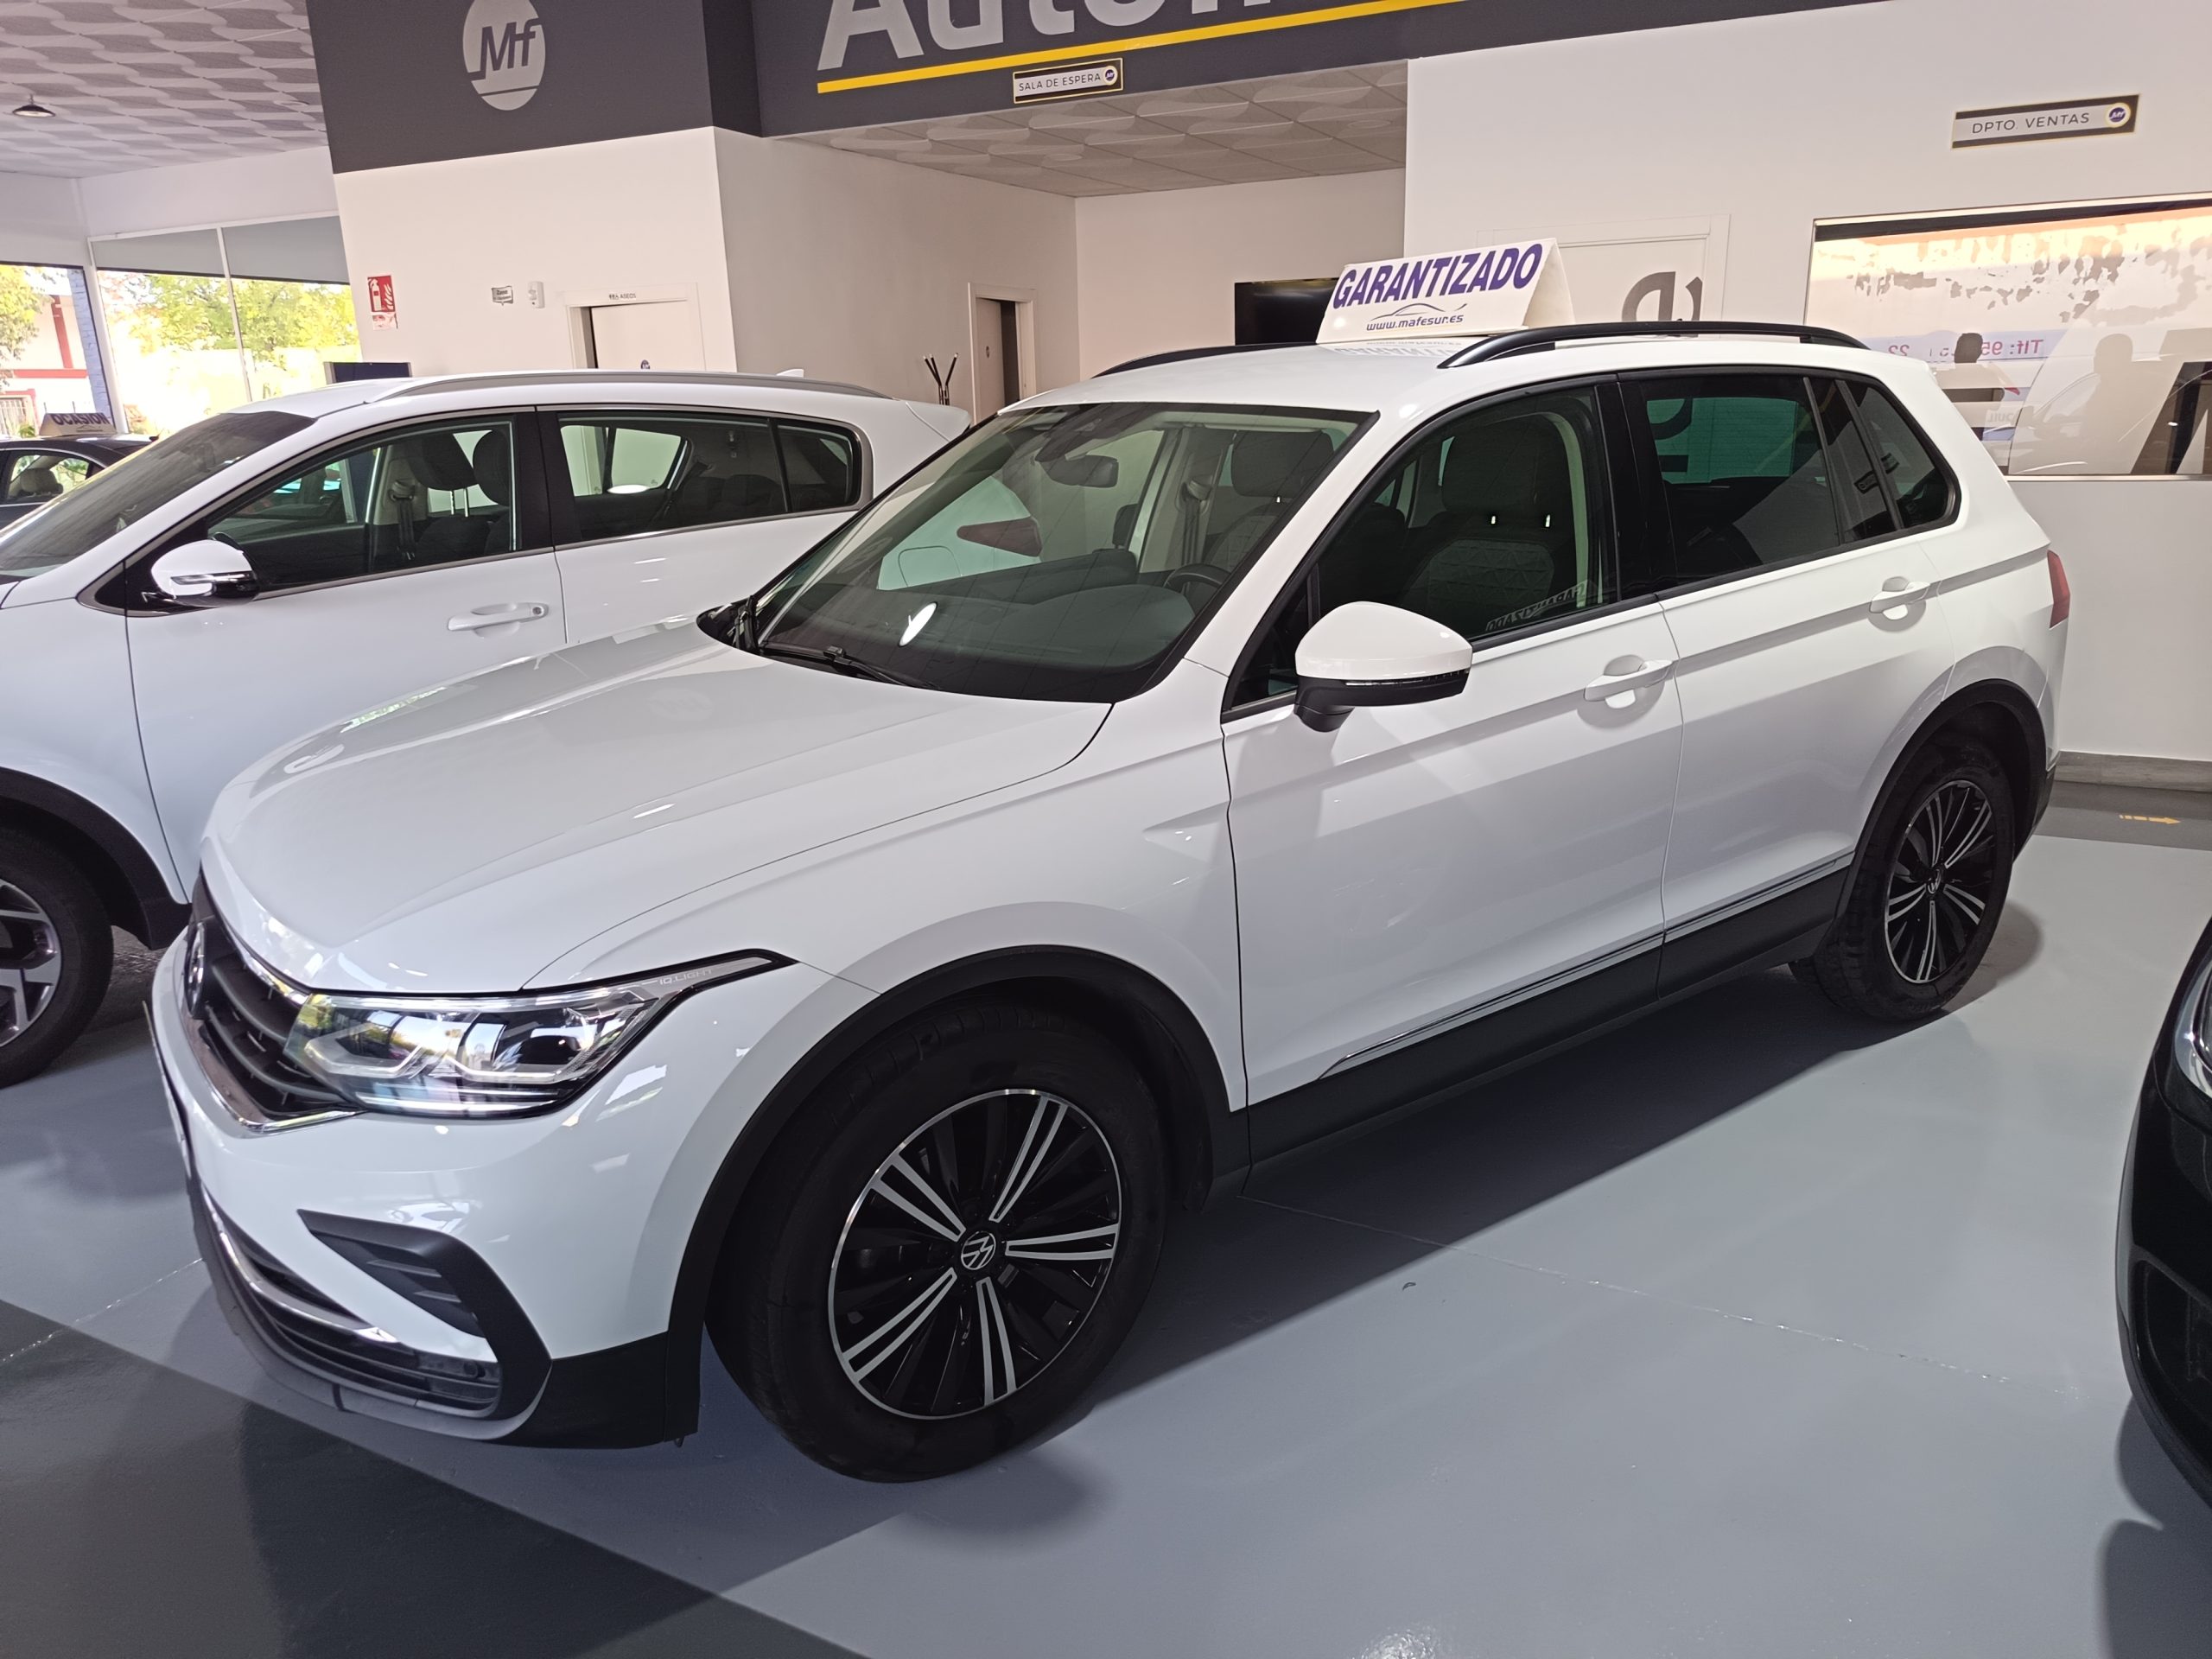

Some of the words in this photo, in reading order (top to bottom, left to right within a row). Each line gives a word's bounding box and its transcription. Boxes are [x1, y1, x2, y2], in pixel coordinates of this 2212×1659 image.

[1019, 81, 1043, 92] SALA
[1046, 78, 1058, 88] DE
[1062, 73, 1101, 86] ESPERA
[2025, 112, 2090, 129] VENTAS
[1332, 243, 1543, 309] GARANTIZADO
[1366, 314, 1465, 331] www.mafesur.es
